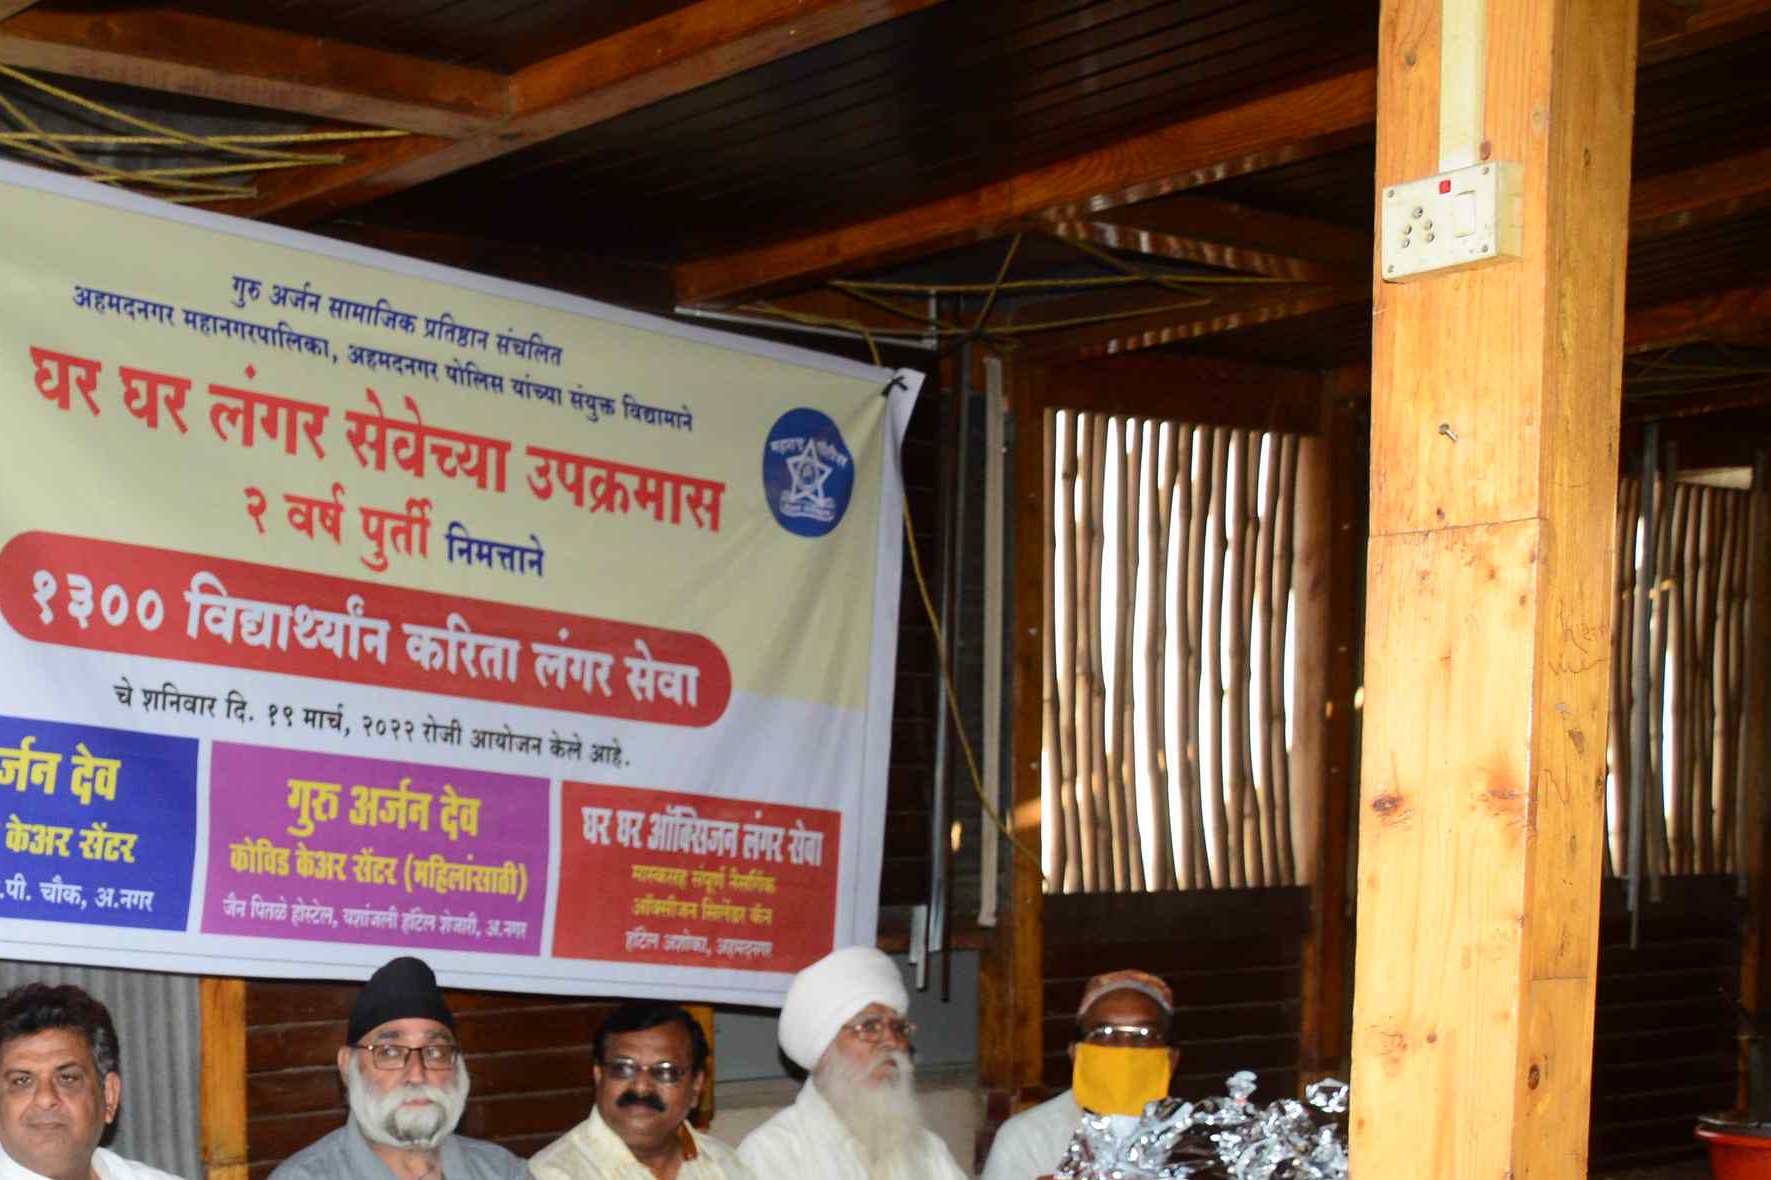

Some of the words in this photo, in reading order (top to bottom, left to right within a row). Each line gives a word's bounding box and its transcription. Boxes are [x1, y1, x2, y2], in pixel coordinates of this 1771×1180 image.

[73, 285, 176, 327] अहमदनगर
[182, 306, 338, 364] महानगरपालिका,
[347, 344, 438, 382] अहमदनगर
[445, 357, 504, 394] पोलिस
[510, 372, 562, 406] यांच्या
[567, 384, 616, 422] संयुक्त
[232, 276, 262, 308] गुरु
[270, 281, 322, 314] अर्जन
[328, 296, 418, 334] सामाजिक
[424, 312, 489, 350] प्रतिष्ठान
[496, 327, 564, 366] संचलित
[30, 345, 102, 418] घर
[119, 365, 192, 435] घर
[208, 364, 329, 460] लंगर
[344, 387, 511, 493] सेवेच्या
[526, 443, 725, 533] उपक्रमास
[246, 485, 268, 535] २
[284, 482, 343, 545] वर्ष
[359, 496, 432, 573] पुर्ती
[445, 522, 545, 577] निमत्ताने
[32, 568, 166, 631] १३००
[400, 611, 522, 684] करिता
[531, 626, 614, 698] लंगर
[623, 638, 700, 707] सेवा
[112, 676, 133, 708] चे
[141, 682, 217, 718] शनिवार
[225, 689, 254, 723] दि.
[268, 702, 294, 727] १९
[302, 698, 351, 737] मार्च,
[362, 713, 416, 741] २०२२
[422, 713, 462, 747] रोजी
[469, 723, 543, 757] आयोजन
[549, 730, 583, 762] केले
[590, 736, 632, 769] आहे.
[70, 742, 122, 805] देव
[286, 778, 342, 838] गुरु
[348, 777, 433, 832] अर्जन
[439, 783, 482, 841] देव
[5, 813, 74, 858] केअर
[78, 821, 139, 863] सेंटर
[229, 836, 290, 876] कोविड
[295, 841, 347, 881] केअर
[352, 847, 399, 885] सेंटर
[581, 806, 613, 846] घर
[615, 808, 645, 849] घर
[94, 884, 156, 912] अ.नगर
